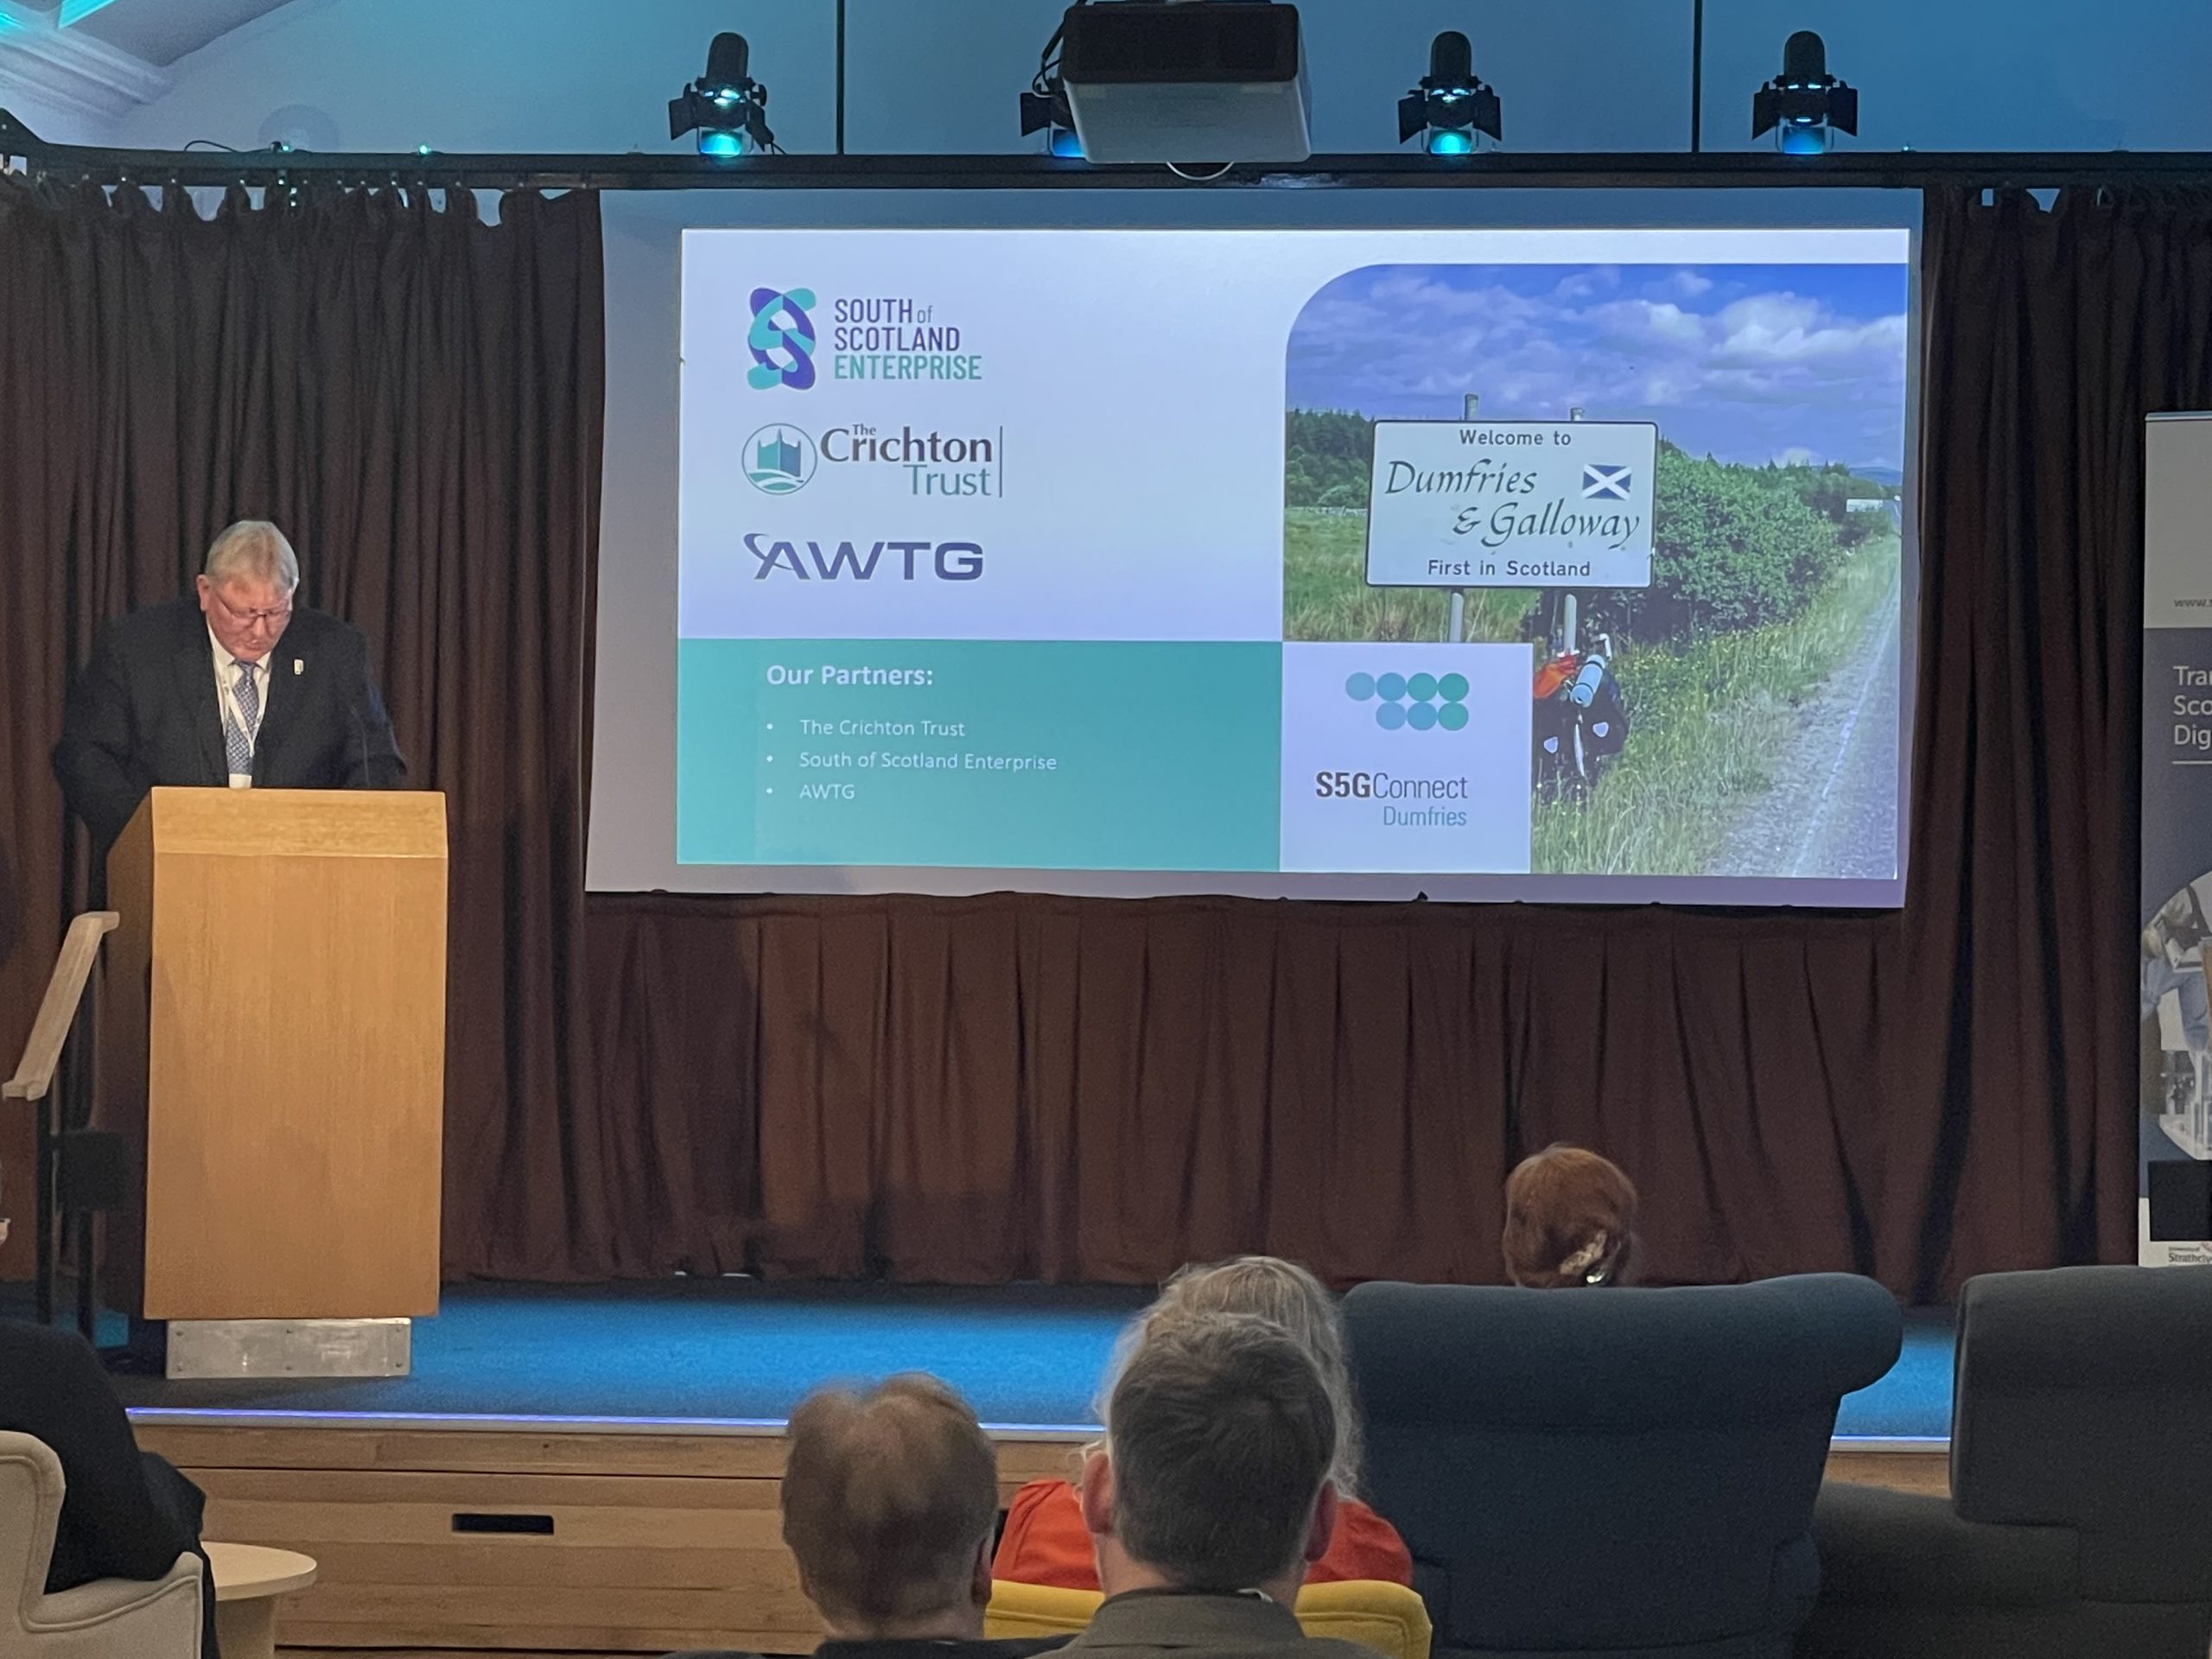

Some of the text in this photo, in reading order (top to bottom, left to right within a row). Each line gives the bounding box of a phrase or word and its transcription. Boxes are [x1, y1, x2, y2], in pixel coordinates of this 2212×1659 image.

[834, 298, 932, 324] SOUTH of
[834, 327, 961, 352] SCOTLAND
[834, 355, 982, 380] ENTERPRISE
[852, 423, 876, 436] The
[1459, 429, 1572, 446] Welcome to
[820, 426, 993, 462] Crichton
[903, 464, 992, 496] Trust
[1384, 458, 1538, 495] Dumfries
[1452, 498, 1640, 550] & Galloway
[743, 532, 984, 581] AWTG
[1428, 559, 1591, 576] First in Scotland
[766, 664, 933, 685] Our Partners:
[2172, 665, 2212, 686] Tra
[2173, 695, 2212, 715] Sco
[799, 719, 965, 736] The Crichton Trust
[2174, 724, 2212, 750] Dig
[799, 752, 1058, 772] South of Scotland Enterprise
[799, 785, 855, 799] AWTG
[1315, 772, 1468, 798] S5GConnect
[1382, 806, 1467, 826] Dumfries
